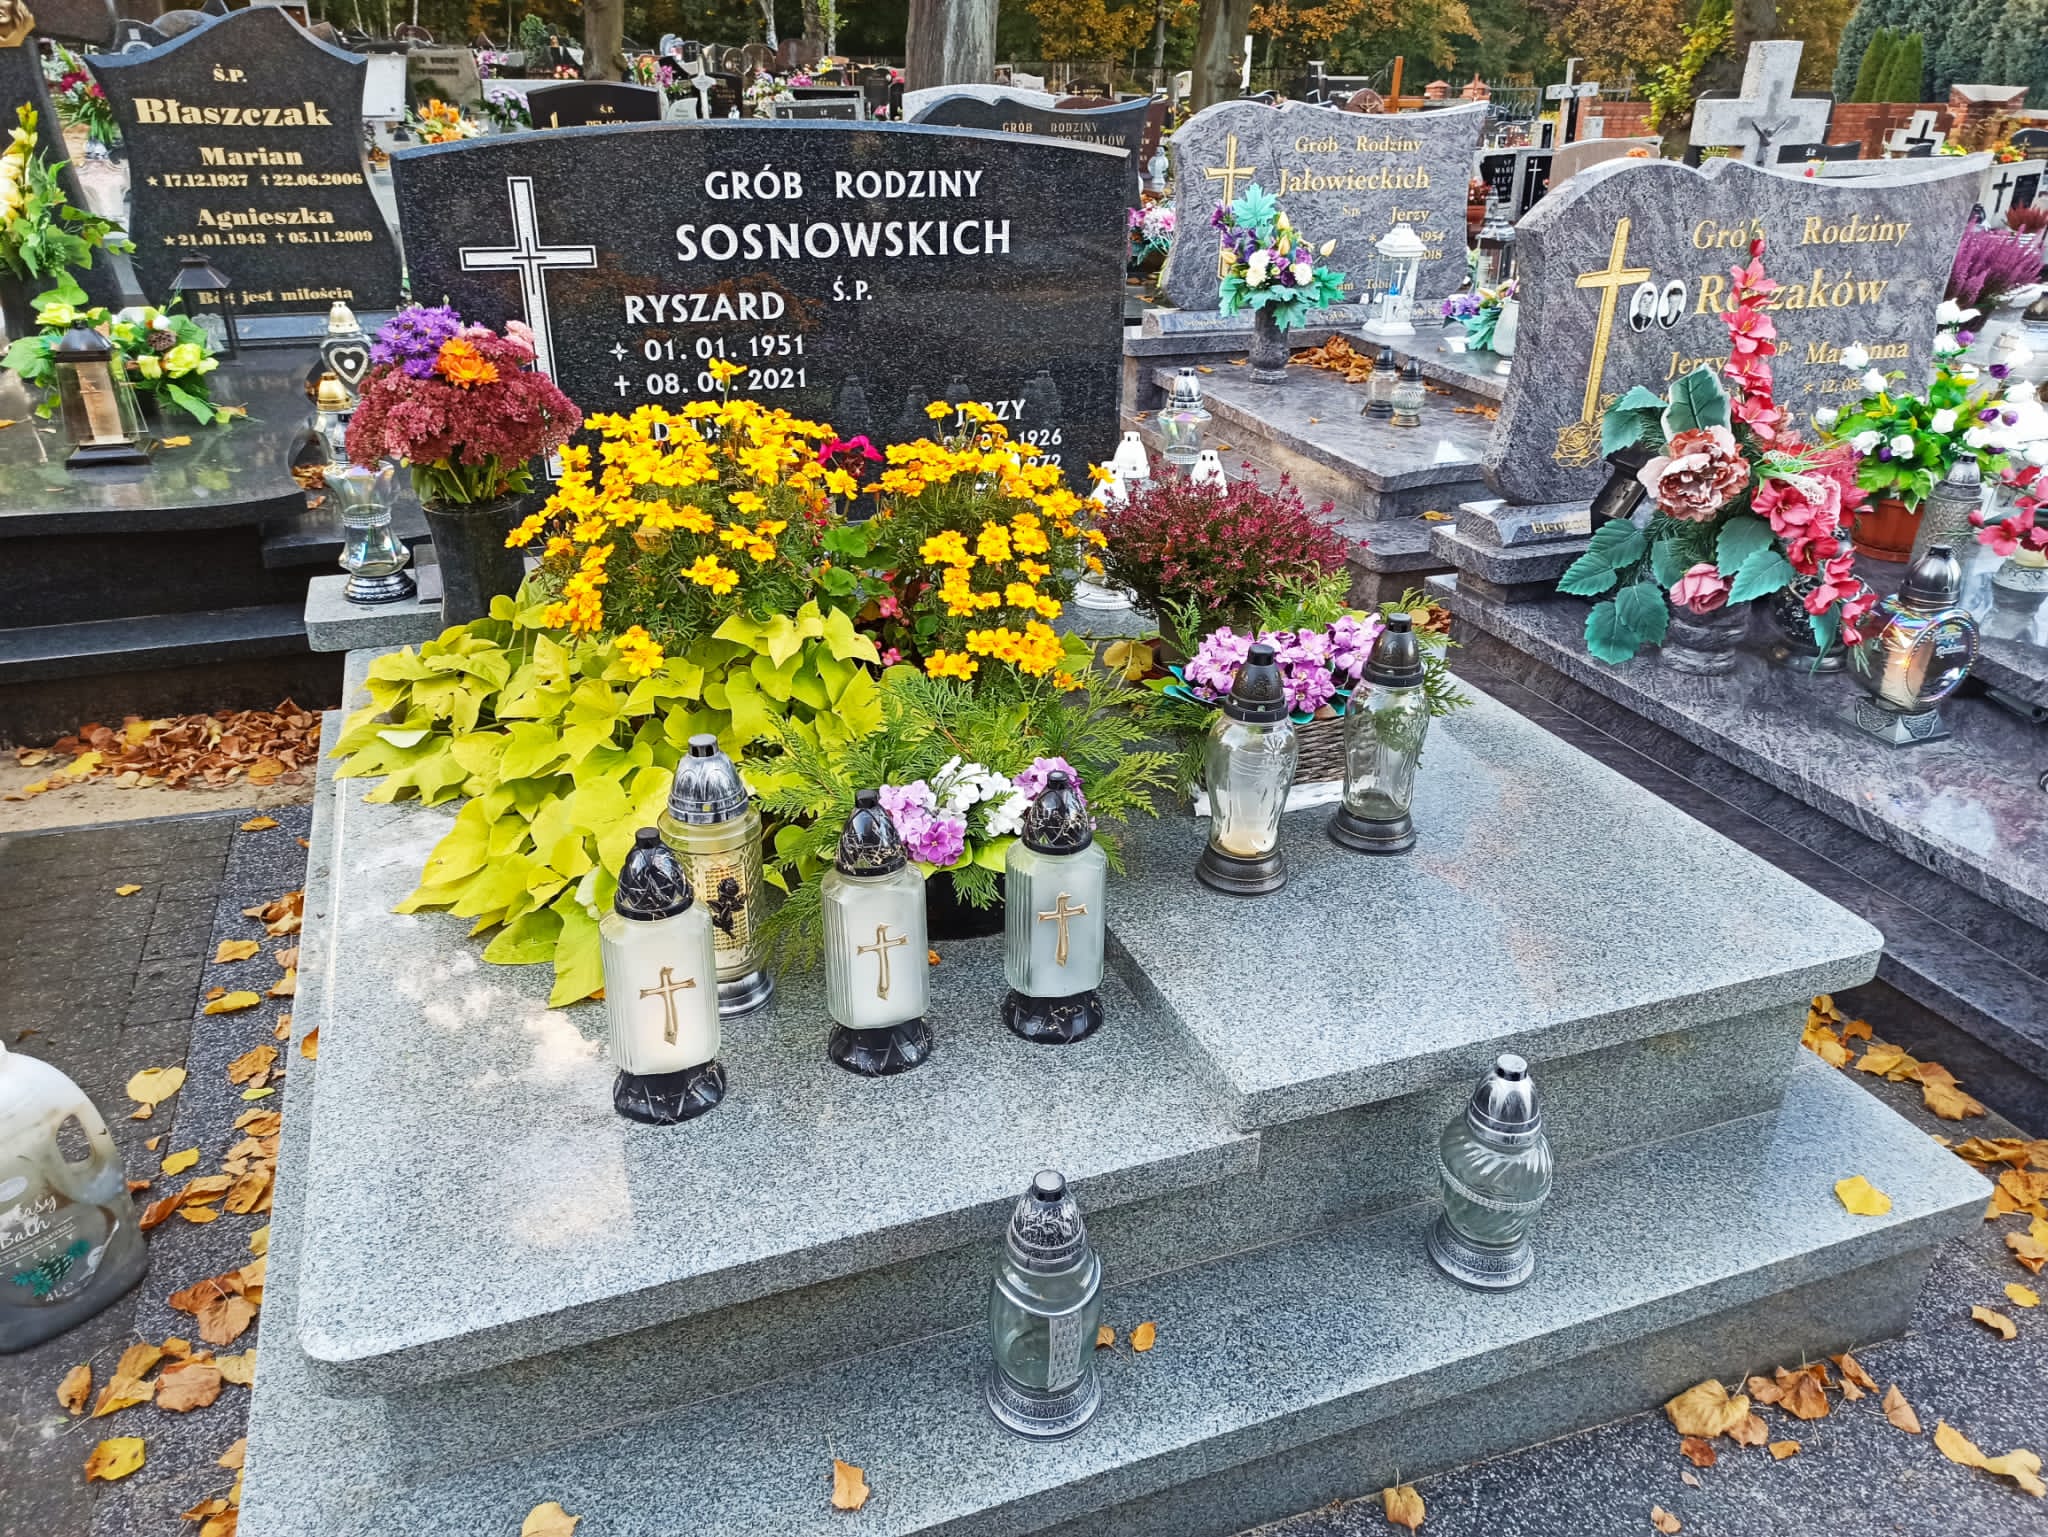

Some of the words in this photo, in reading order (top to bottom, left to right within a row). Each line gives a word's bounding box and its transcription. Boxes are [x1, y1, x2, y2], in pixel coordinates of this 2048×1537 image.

[132, 97, 333, 126] Błaszczak
[1002, 119, 1033, 133] GRÓB
[1050, 121, 1098, 133] RODZINY
[1295, 134, 1339, 153] Grób
[1355, 134, 1423, 154] Rodziny
[199, 147, 304, 167] Marian
[163, 173, 249, 188] 17.12.1937
[272, 173, 363, 187] 22.06.2006
[704, 163, 803, 200] GRÓB
[835, 169, 984, 199] RODZINY
[1277, 165, 1431, 198] Jałowieckich
[197, 207, 335, 231] Agnieszka
[1388, 206, 1430, 225] Jerzy
[178, 233, 267, 247] 21.01.1943
[288, 230, 373, 244] 05.11.2009
[675, 218, 1012, 262] SOSNOWSKICH
[1800, 213, 1912, 247] Rodziny
[242, 289, 273, 305] jest
[832, 275, 873, 302] Ś.P.
[1694, 267, 1889, 315] Rzaków
[624, 291, 786, 325] RYSZARD
[748, 333, 804, 357] 1951
[747, 367, 807, 391] 2021
[954, 397, 1027, 428] JZY
